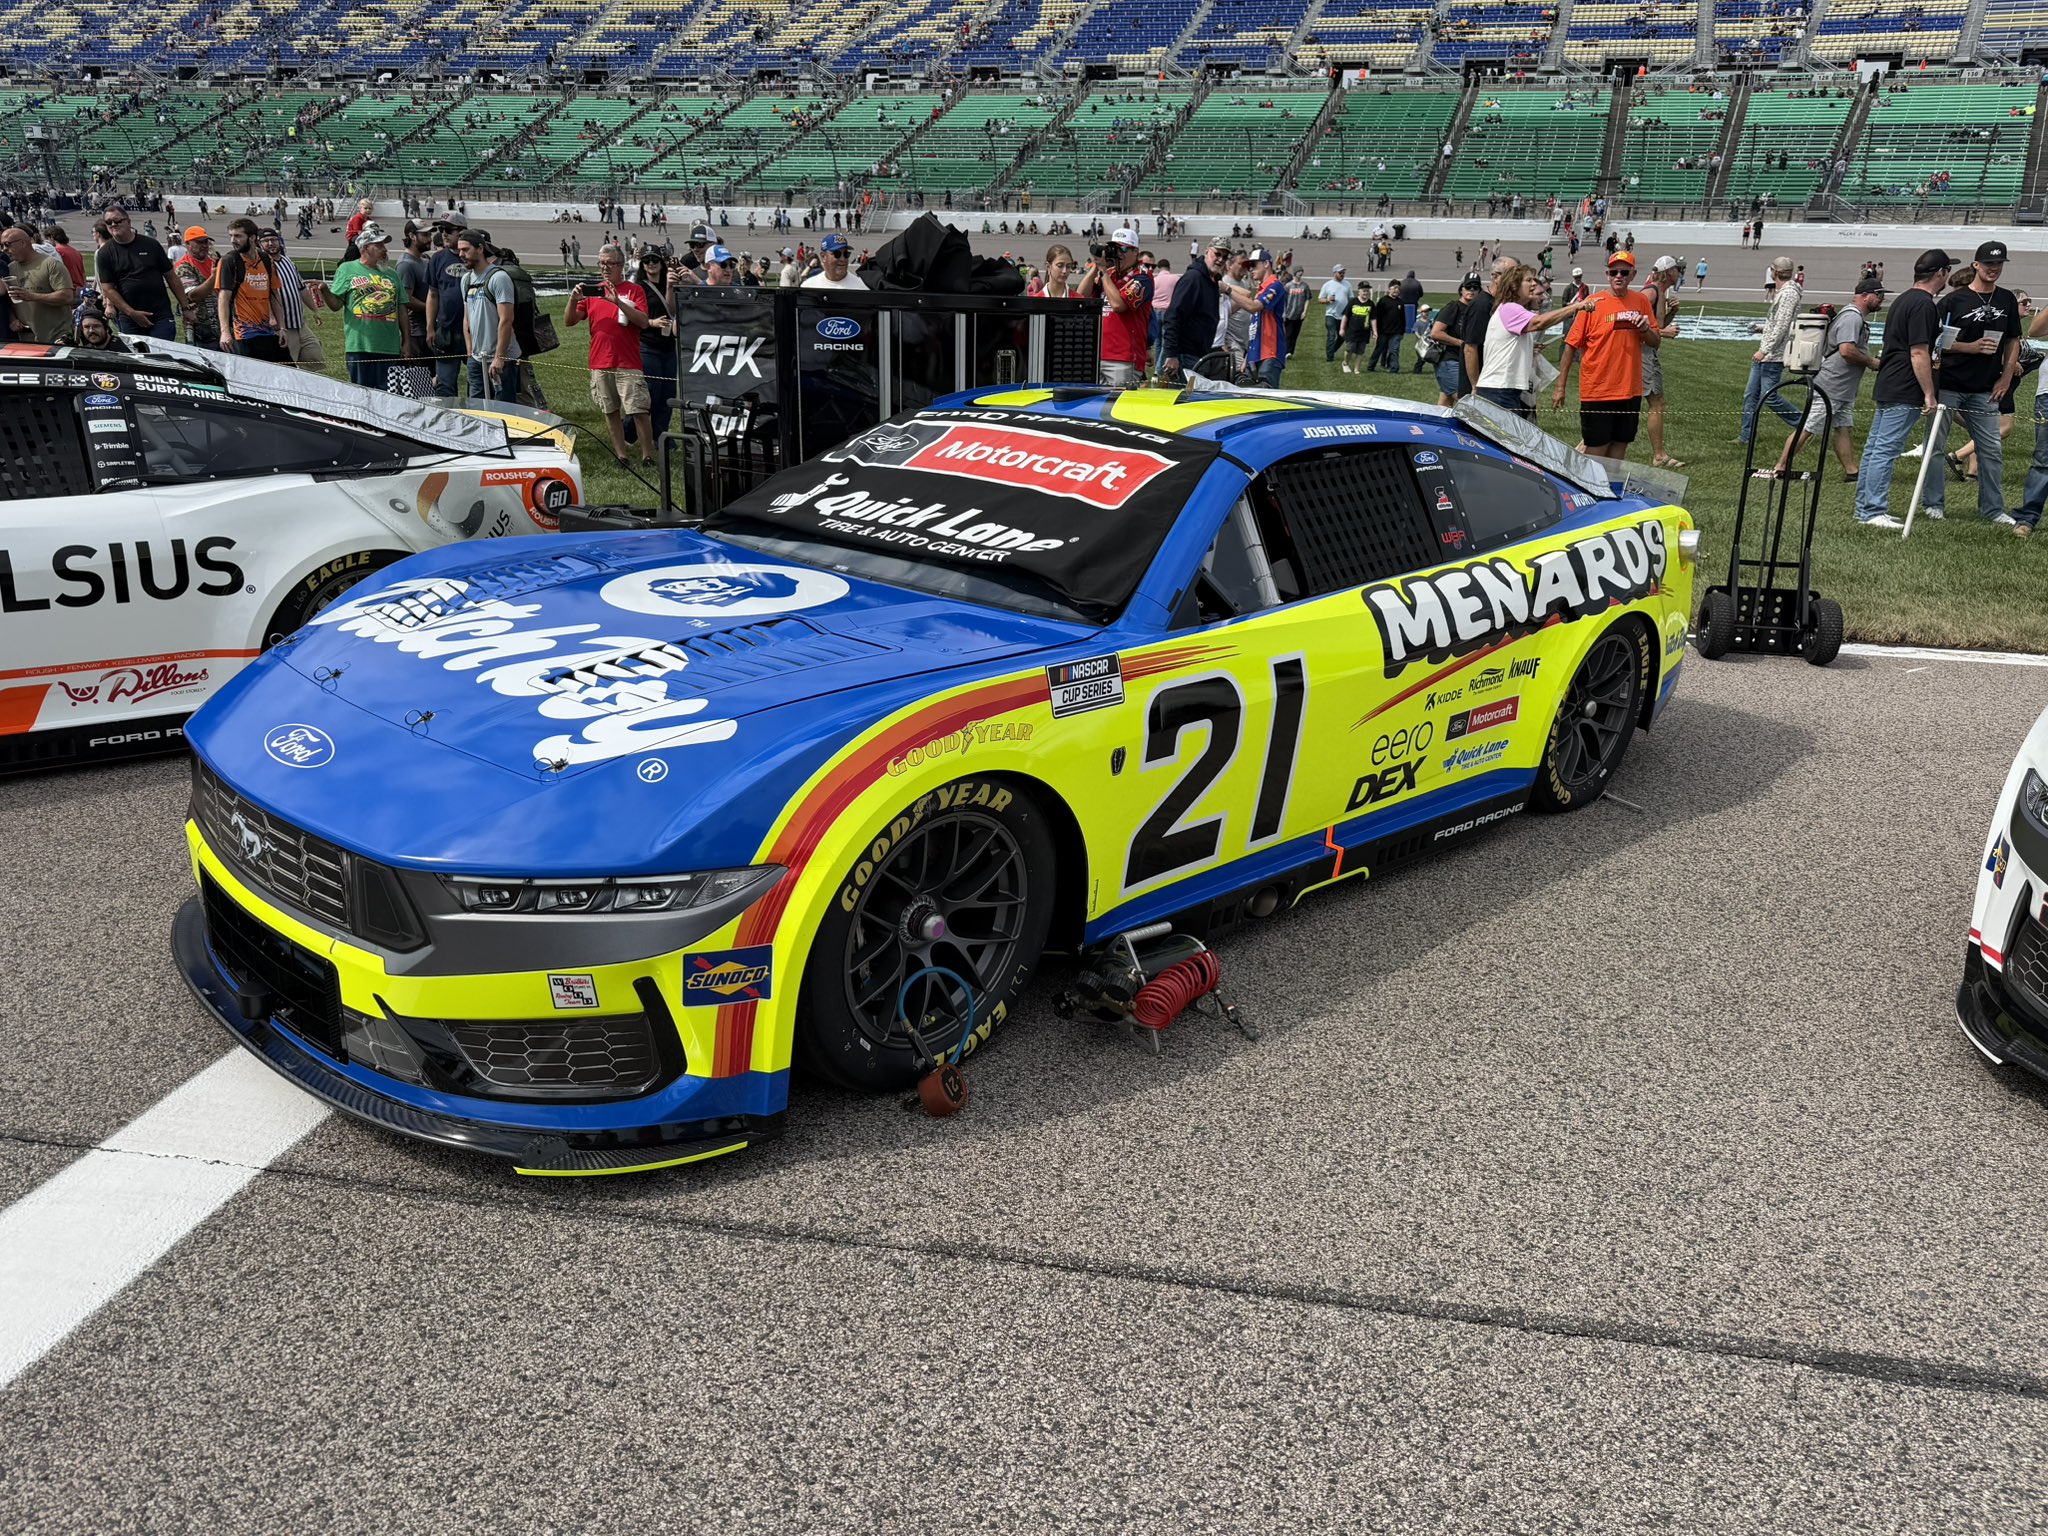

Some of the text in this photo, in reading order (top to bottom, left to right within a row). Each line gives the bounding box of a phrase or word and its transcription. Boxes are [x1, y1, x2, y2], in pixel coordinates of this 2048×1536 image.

[824, 319, 853, 337] Ford
[689, 334, 766, 378] RFK
[813, 343, 864, 351] RACING
[133, 374, 180, 386] BUILD
[914, 411, 1174, 445] FORD RACING
[1302, 424, 1379, 439] JOSH BERRY
[935, 440, 1128, 490] Motorcraft
[549, 490, 568, 508] 60
[814, 491, 946, 527] Quick
[927, 508, 1064, 552] Lane
[818, 518, 1012, 562] TIRE & AUTO CENTER
[0, 536, 246, 613] LSIUS
[305, 551, 371, 592] EAGLE
[1366, 520, 1665, 664] MENARDS
[26, 651, 205, 675] ROUSH FENWAY KESELOWSKI RACING
[1072, 659, 1109, 680] NASCAR
[1508, 657, 1541, 679] KNAUF
[1637, 632, 1650, 690] EAGLE
[100, 663, 209, 702] Dillons
[1062, 680, 1113, 704] CUP SERIES
[1437, 688, 1463, 705] KIDDE
[1468, 671, 1505, 692] Richmond
[1471, 704, 1513, 726] Motorcraft
[89, 730, 161, 748] FORD
[270, 727, 324, 763] Ford
[886, 719, 1034, 777] GOODYEAR
[1371, 721, 1434, 766] eero
[1457, 739, 1510, 765] Quick Lane
[1122, 652, 1306, 896] 21
[1345, 756, 1427, 813] DEX
[1434, 803, 1524, 841] FORD RACING
[840, 782, 1013, 912] GOODYEAR
[689, 966, 767, 988] SUNOCO
[945, 1076, 959, 1096] 21
